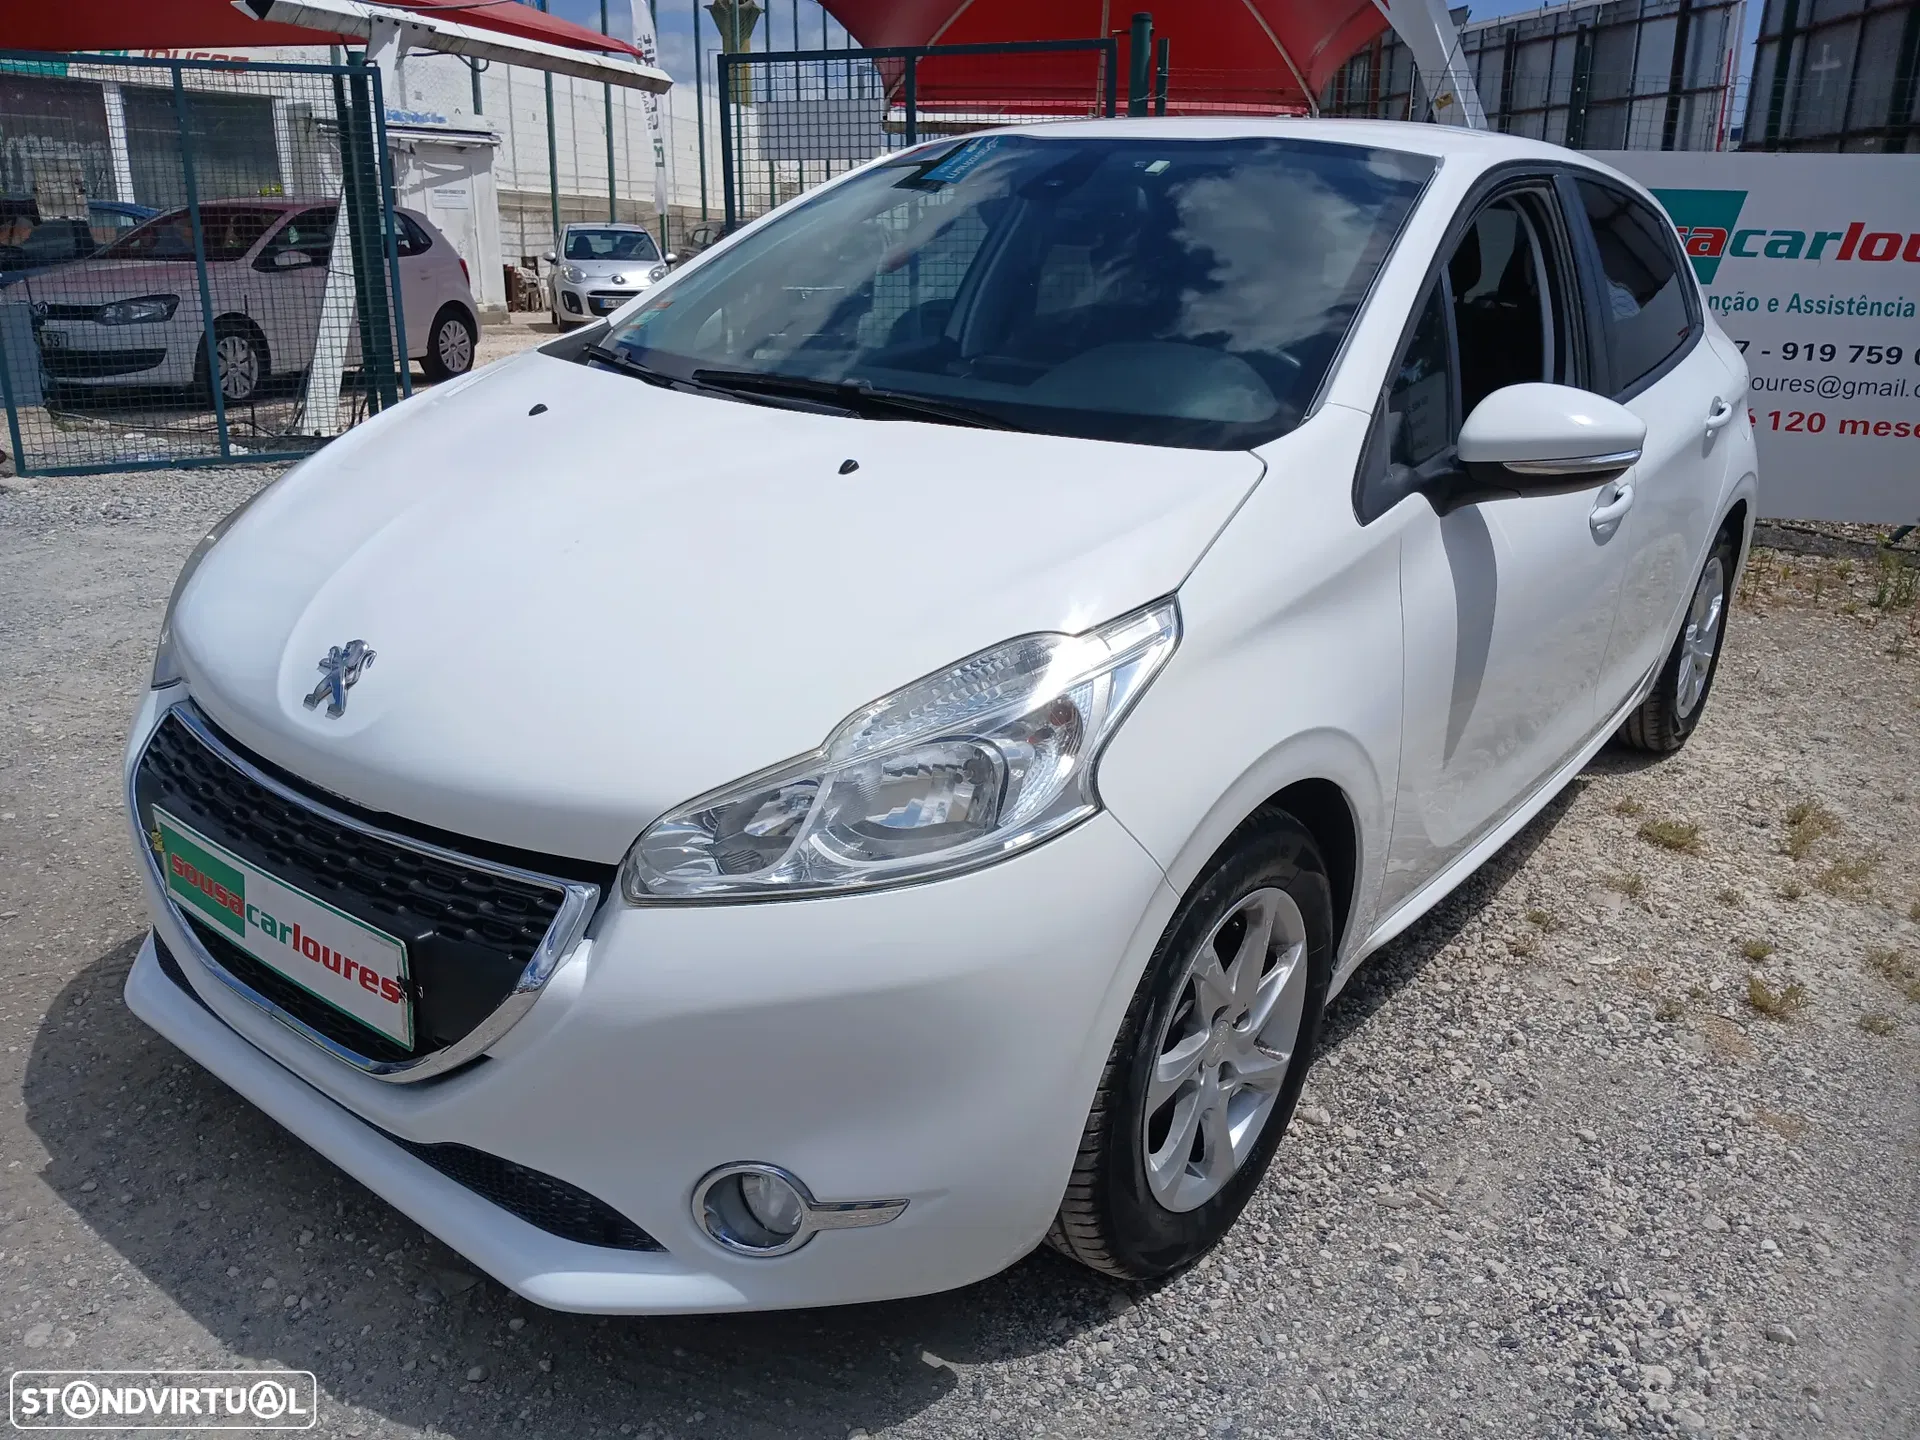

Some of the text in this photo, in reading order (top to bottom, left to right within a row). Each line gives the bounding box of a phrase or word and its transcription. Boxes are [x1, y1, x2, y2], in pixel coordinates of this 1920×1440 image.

[1767, 297, 1779, 313] e
[1786, 293, 1916, 318] Assistência
[1782, 342, 1837, 362] 919
[1848, 345, 1904, 365] 759
[1768, 410, 1826, 433] 120
[171, 852, 403, 1004] sousacarloures
